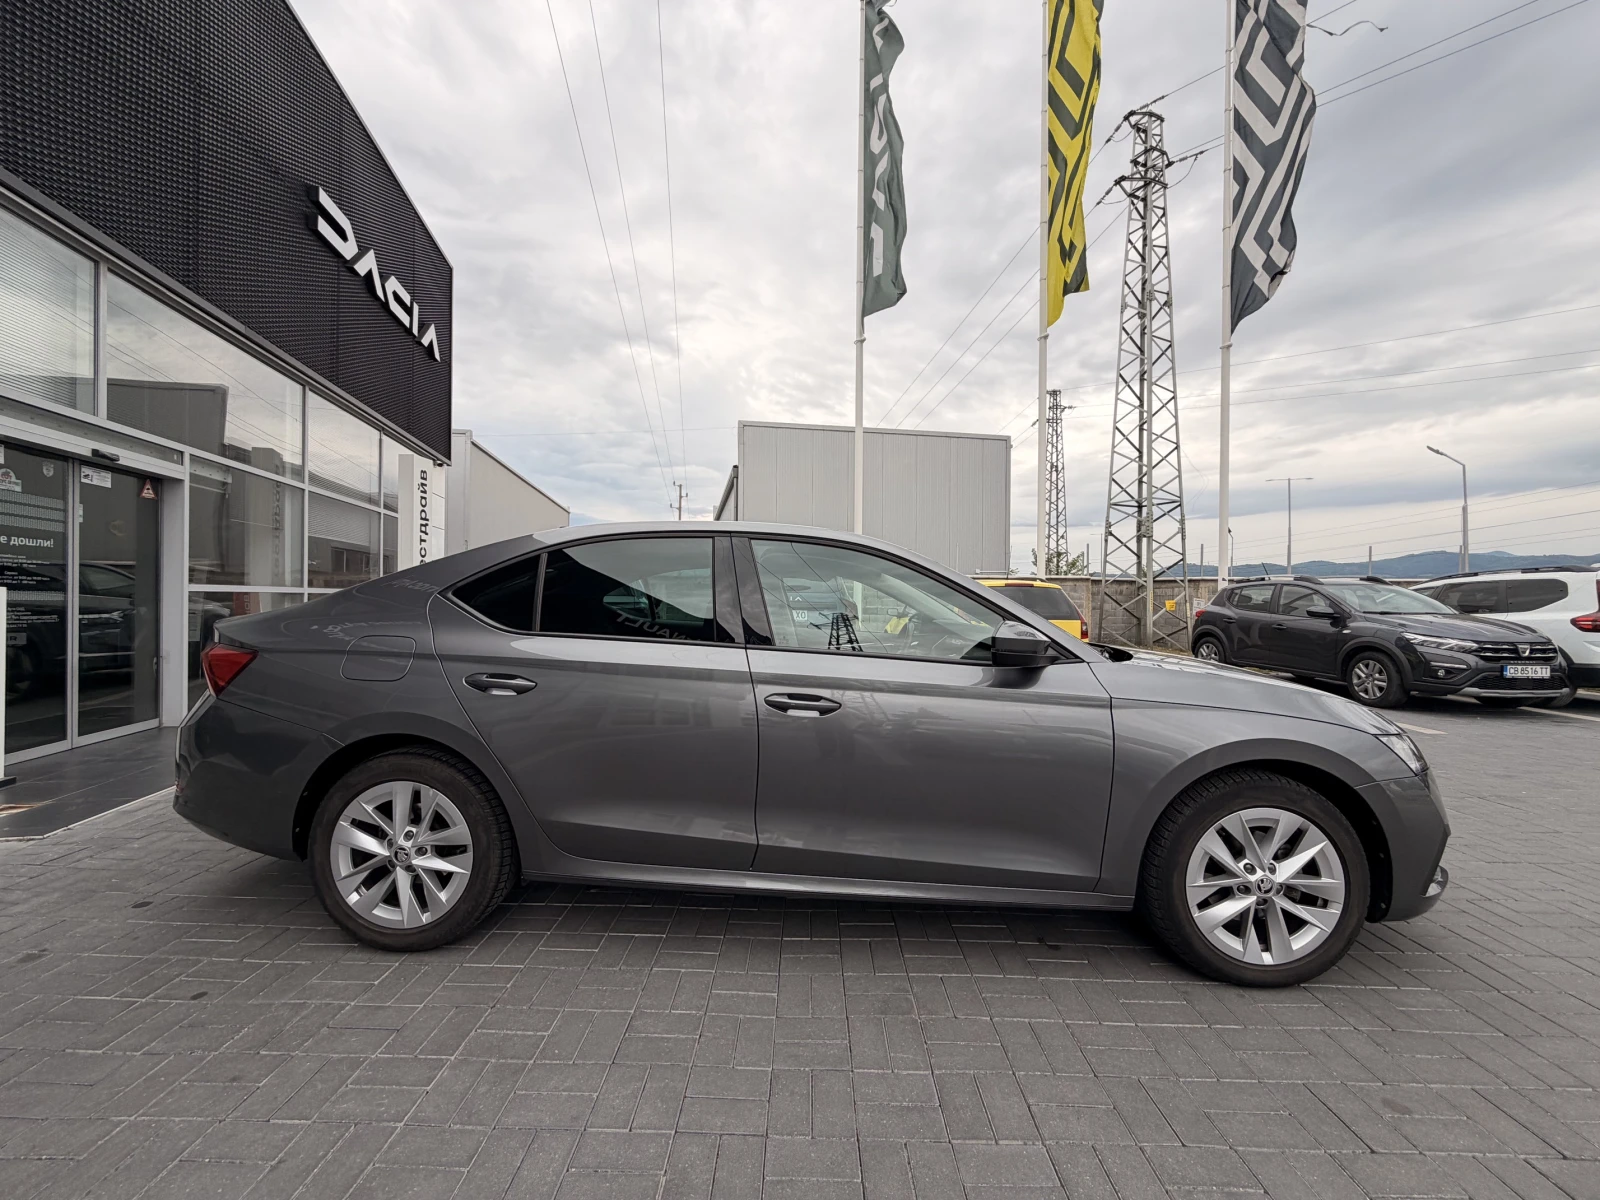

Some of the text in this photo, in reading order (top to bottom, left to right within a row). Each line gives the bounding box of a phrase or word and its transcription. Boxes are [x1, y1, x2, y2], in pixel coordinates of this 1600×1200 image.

[315, 185, 441, 363] DACIA
[9, 536, 54, 548] дошли!
[418, 469, 430, 566] стдрайв
[1508, 666, 1549, 675] CB 8516 TT
